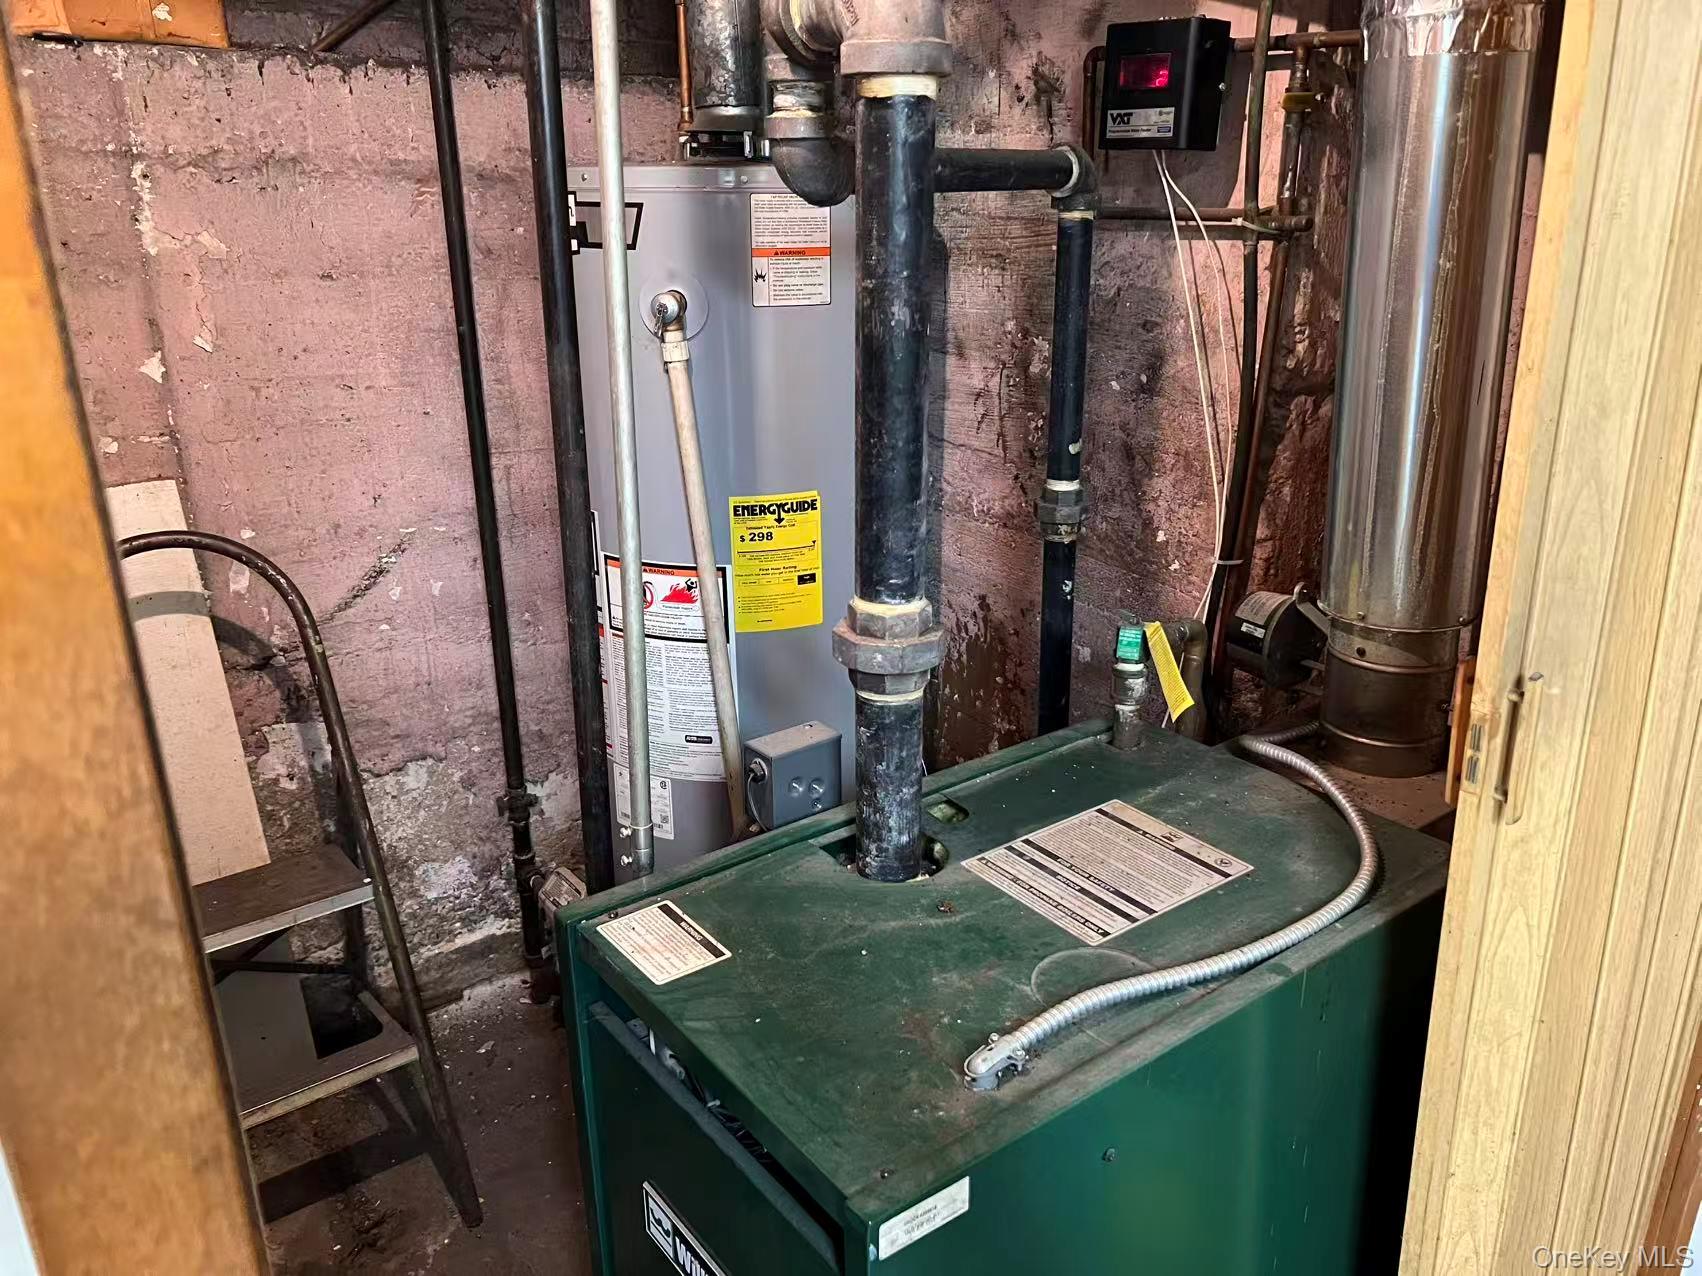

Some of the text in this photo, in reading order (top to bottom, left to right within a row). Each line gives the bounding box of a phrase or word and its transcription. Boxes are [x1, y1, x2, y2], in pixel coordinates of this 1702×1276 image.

[1110, 112, 1133, 125] VXT
[733, 499, 817, 517] ENERGYGUIDE
[749, 531, 773, 542] 298
[1056, 875, 1081, 890] NOTICE
[1088, 876, 1115, 891] SAFETY
[679, 921, 703, 941] WARNING
[1085, 921, 1104, 933] ONLY
